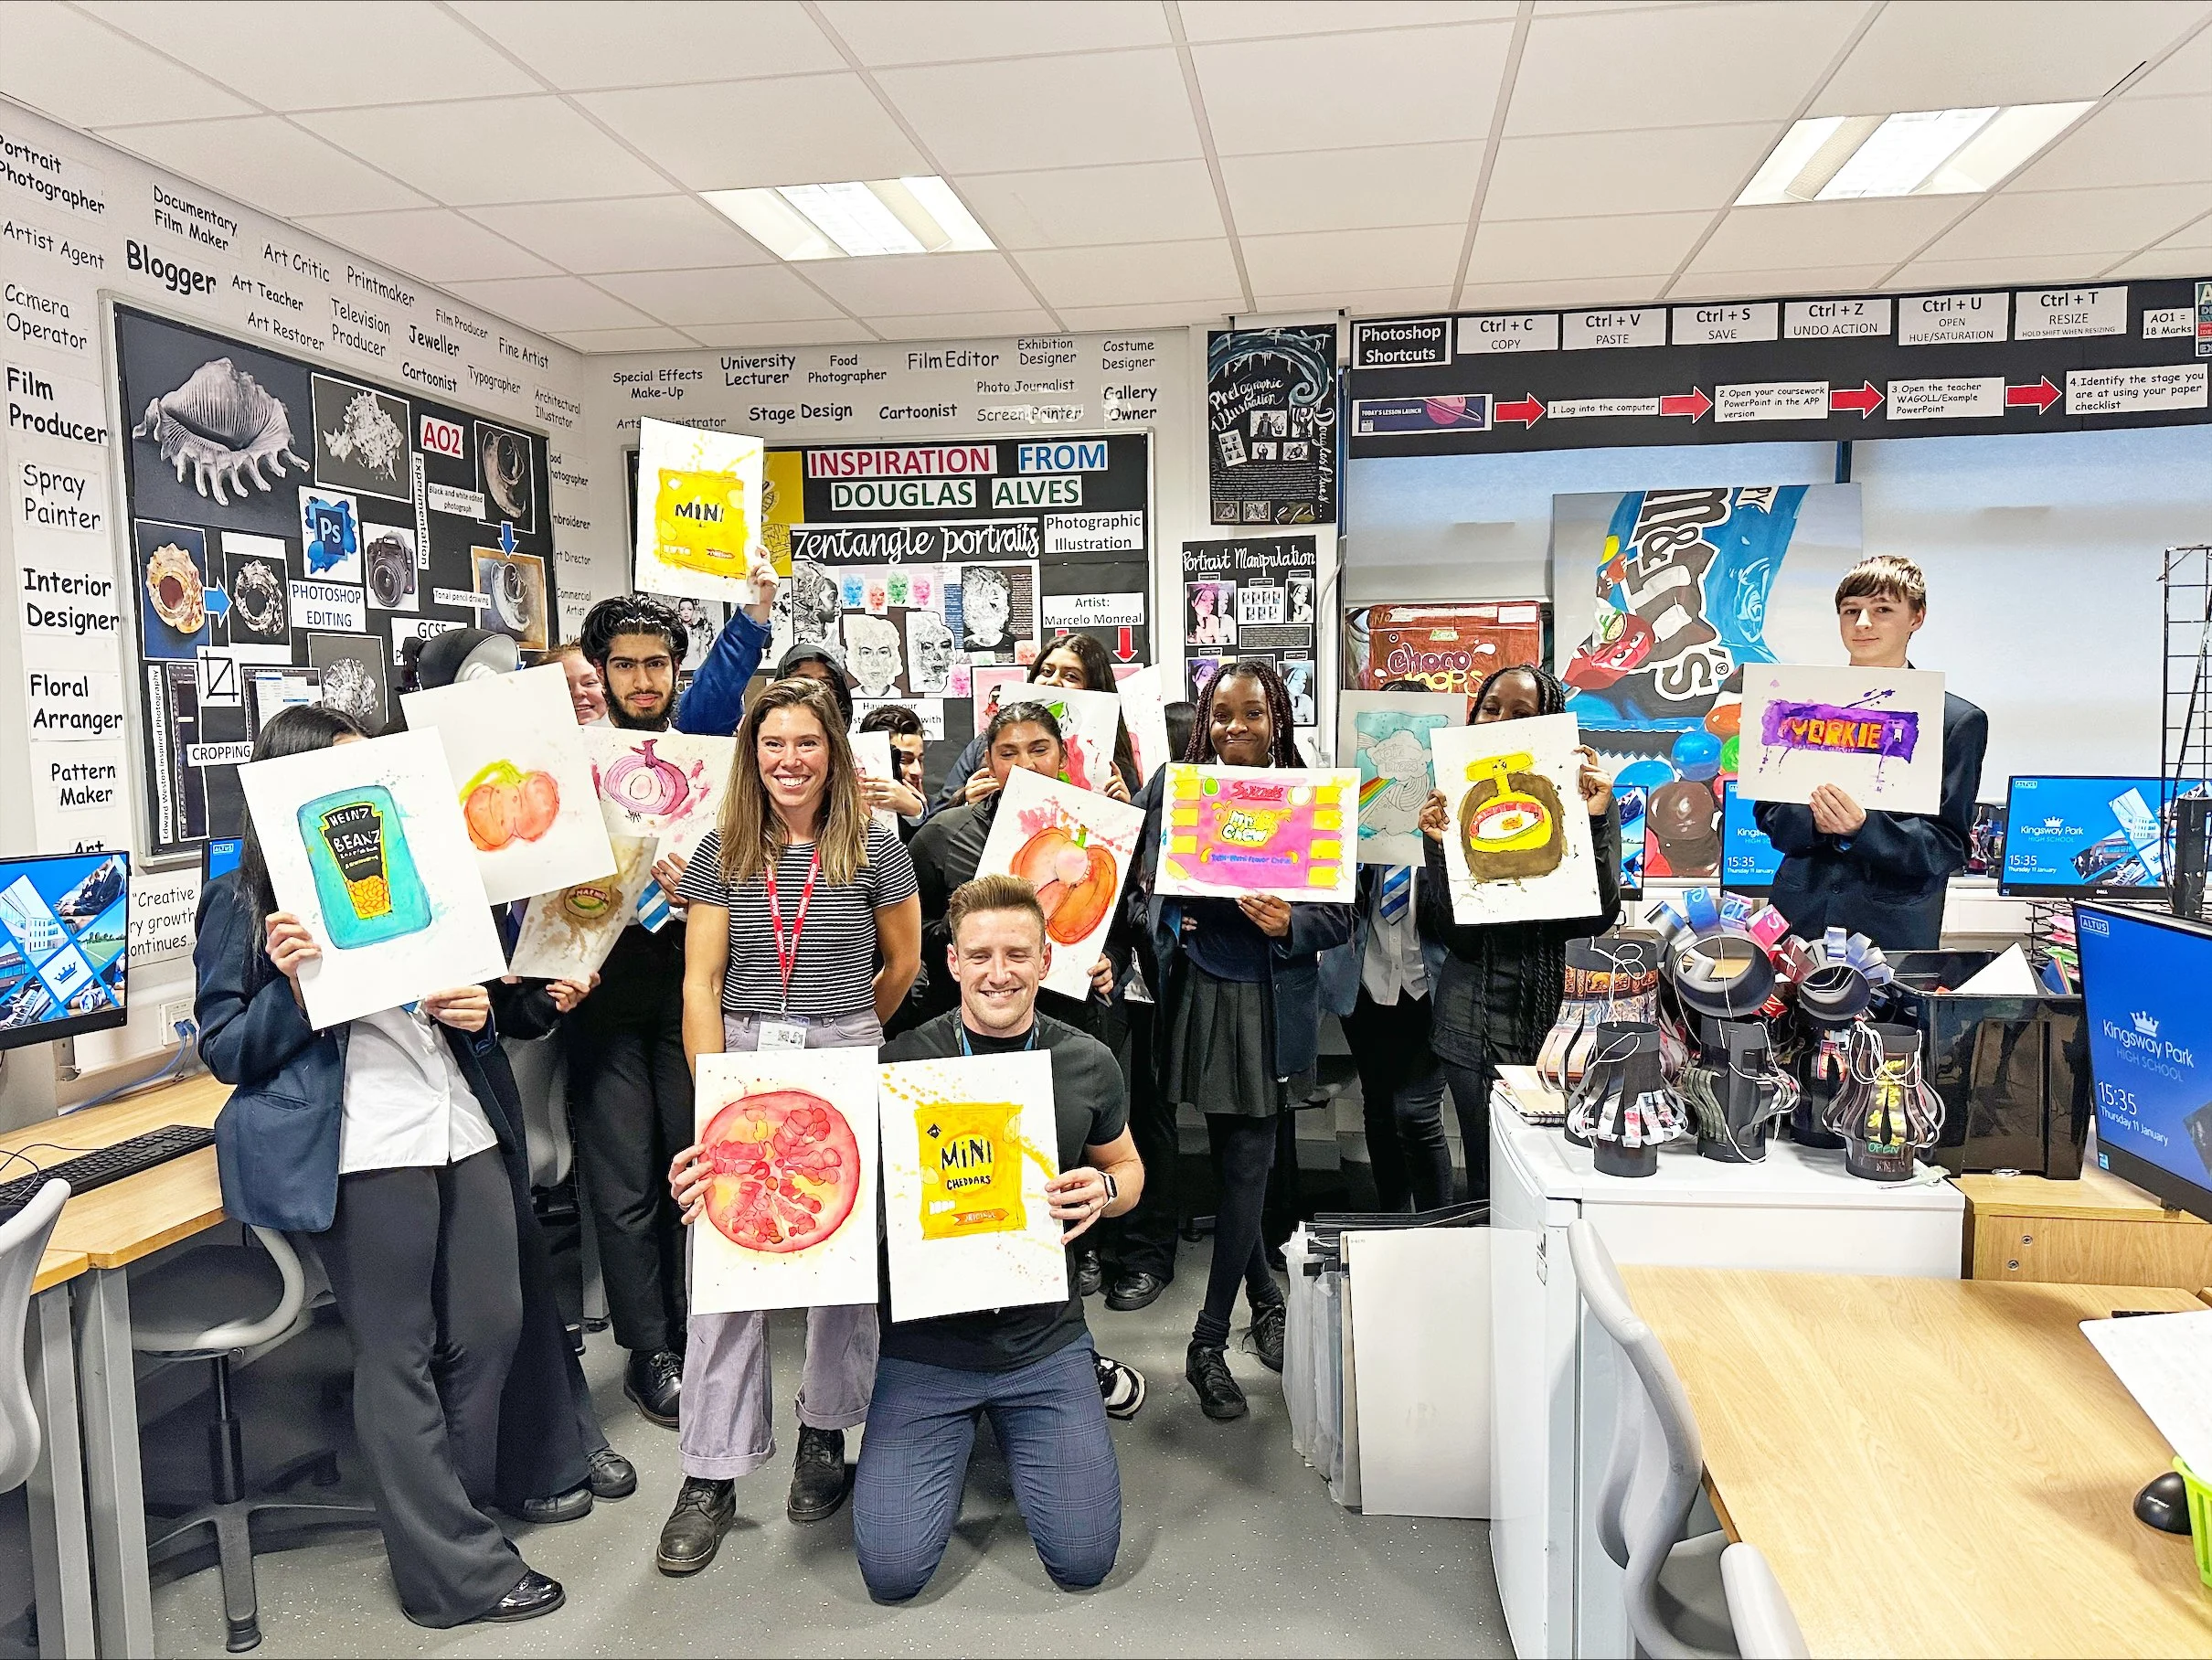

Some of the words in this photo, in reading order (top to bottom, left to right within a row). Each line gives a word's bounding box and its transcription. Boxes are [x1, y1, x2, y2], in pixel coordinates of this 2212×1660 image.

[153, 185, 238, 237] Documentary
[154, 209, 183, 234] Film
[188, 223, 229, 251] Maker
[4, 221, 54, 252] Artist
[60, 241, 104, 270] Agent
[126, 239, 217, 295] Blogger
[263, 243, 288, 266] Art
[292, 254, 330, 283] Critic
[232, 274, 252, 293] Art
[257, 282, 303, 312] Teacher
[347, 265, 415, 308] Printmaker
[1922, 298, 1951, 314] Ctrl
[1971, 297, 1982, 311] U
[2040, 293, 2068, 307] Ctrl
[2088, 292, 2099, 304] T
[331, 298, 391, 335] Television
[1696, 309, 1723, 323] Ctrl
[1742, 308, 1750, 321] S
[1809, 303, 1835, 318] Ctrl
[1855, 303, 1864, 315] Z
[2151, 313, 2175, 324] AO1
[1480, 319, 1505, 333] Ctrl
[1524, 319, 1533, 330] C
[1585, 314, 1611, 328] Ctrl
[1630, 314, 1641, 326] V
[1939, 317, 1965, 327] OPEN
[2049, 313, 2089, 325] RESIZE
[6, 313, 87, 350] Operator
[248, 312, 269, 332] Art
[273, 320, 324, 352] Restorer
[1362, 326, 1441, 342] Photoshop
[1708, 329, 1737, 340] SAVE
[1793, 325, 1828, 336] UNDO
[1832, 324, 1878, 335] ACTION
[1909, 330, 1994, 343] HUE/SATURATION
[2145, 325, 2158, 335] 18
[2161, 324, 2192, 335] Marks
[332, 324, 387, 357] Producer
[409, 325, 460, 357] Jeweller
[1017, 339, 1073, 350] Exhibition
[1103, 340, 1154, 352] Costume
[1492, 339, 1520, 350] COPY
[1596, 333, 1629, 345] PASTE
[498, 337, 519, 360] Fine
[522, 344, 549, 370] Artist
[830, 355, 857, 367] Food
[909, 353, 942, 369] Film
[946, 351, 999, 367] Editor
[1020, 353, 1077, 367] Designer
[1366, 348, 1436, 364] Shortcuts
[721, 354, 795, 370] University
[1102, 356, 1154, 371] Designer
[6, 367, 54, 400] Film
[402, 362, 458, 393] Cartoonist
[468, 365, 521, 395] Typographer
[612, 370, 653, 383] Special
[659, 369, 703, 381] Effects
[726, 372, 789, 386] Lecturer
[808, 369, 887, 385] Photographer
[2132, 376, 2148, 385] the
[2151, 374, 2182, 385] stage
[2185, 372, 2205, 382] you
[631, 388, 684, 399] Make-Up
[977, 381, 1010, 393] Photo
[1015, 380, 1075, 392] Journalist
[1754, 388, 1773, 398] your
[1777, 387, 1825, 396] coursework
[1929, 383, 1943, 392] the
[1946, 382, 1982, 391] teacher
[2075, 389, 2092, 399] are
[2095, 388, 2110, 398] at
[2112, 388, 2139, 399] using
[2143, 387, 2165, 397] your
[2171, 384, 2202, 395] paper
[1724, 398, 1771, 408] PowerPoint
[1774, 398, 1782, 406] in
[1785, 397, 1800, 406] the
[1803, 397, 1820, 405] APP
[1897, 392, 1978, 404] WAGOLL/Example
[2075, 399, 2121, 411] checklist
[749, 407, 795, 424] Stage
[801, 403, 853, 419] Design
[880, 404, 957, 419] Cartoonist
[1616, 404, 1655, 413] computer
[1724, 410, 1755, 418] version
[1897, 404, 1944, 414] PowerPoint
[9, 403, 107, 444] Producer
[423, 422, 461, 454] AO2
[810, 449, 989, 475] INSPIRATION
[1020, 445, 1105, 471] FROM
[24, 463, 85, 501] Spray
[430, 486, 443, 495] Black
[456, 492, 468, 500] white
[469, 495, 483, 503] edited
[835, 484, 972, 507] DOUGLAS
[995, 481, 1079, 505] ALVES
[25, 497, 101, 529] Painter
[415, 457, 428, 565] Experimentation
[444, 502, 472, 513] photograph
[675, 502, 724, 523] MINI
[321, 517, 341, 543] Ps
[1047, 516, 1141, 532] Photographic
[941, 524, 1039, 560] portraits
[1055, 537, 1132, 549] Illustration
[564, 551, 590, 565] Director
[1183, 548, 1231, 571] Portrait
[1235, 546, 1315, 577] Manipulation
[24, 568, 112, 597] Interior
[292, 584, 361, 603] PHOTOSHOP
[566, 605, 585, 616] Artist
[1075, 597, 1110, 608] Artist:
[27, 602, 119, 634] Designer
[307, 611, 352, 627] EDITING
[1045, 615, 1090, 625] Marcelo
[1094, 612, 1142, 624] Monreal
[30, 674, 89, 697] Floral
[153, 670, 163, 728] Photography
[33, 708, 122, 734] Arranger
[156, 730, 165, 767] inspired
[193, 745, 250, 761] CROPPING
[51, 762, 116, 782] Pattern
[159, 770, 167, 803] Weston
[59, 785, 112, 806] Maker
[161, 806, 170, 839] Edward
[329, 808, 368, 827] HEINZ
[2021, 825, 2063, 835] Kingsway
[2066, 825, 2083, 835] Park
[334, 829, 380, 853] BEANZ
[2009, 855, 2037, 866] 15:35
[2082, 919, 2107, 932] ALTUS
[2103, 1019, 2162, 1058] Kingsway
[2165, 1042, 2194, 1068] Park
[2117, 1047, 2140, 1065] HIGH
[2142, 1054, 2183, 1081] SCHOOL
[2099, 1080, 2137, 1115] 15:35
[2100, 1104, 2132, 1131] Thursday
[2133, 1121, 2140, 1133] 11
[2141, 1123, 2168, 1146] January
[1868, 1143, 1899, 1154] OPEN
[947, 1176, 991, 1190] CHEDDARS
